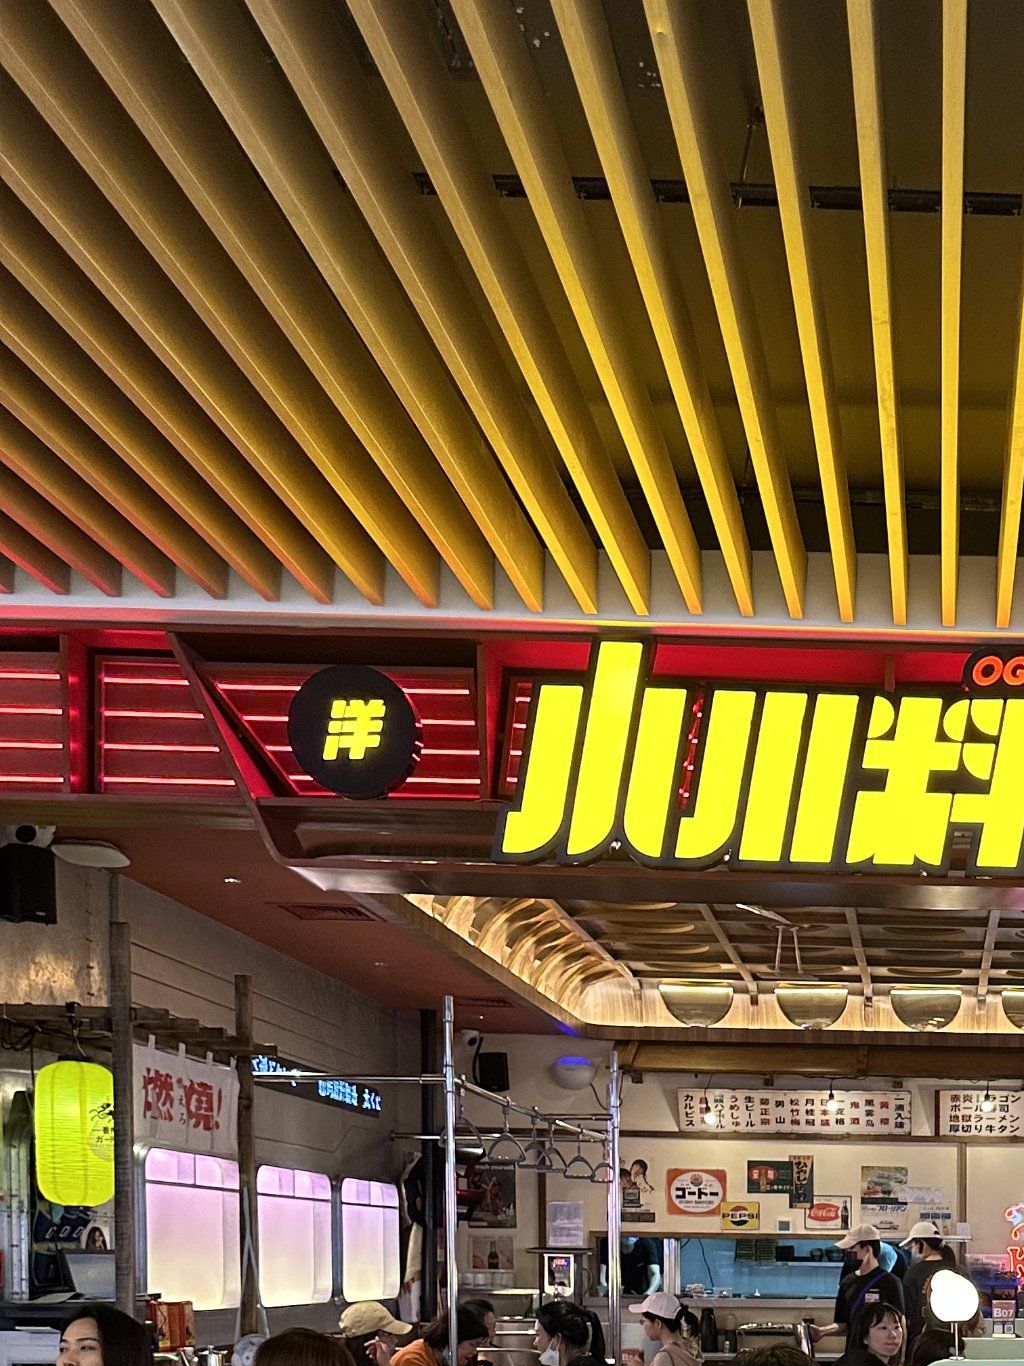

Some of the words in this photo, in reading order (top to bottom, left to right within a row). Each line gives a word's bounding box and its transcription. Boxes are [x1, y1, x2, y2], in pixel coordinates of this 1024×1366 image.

[322, 698, 385, 761] 洋
[949, 1114, 1021, 1124] 地獄ラーメン
[949, 1124, 1020, 1134] 厚切り牛タン
[675, 1186, 719, 1200] ゴードー
[722, 1212, 759, 1220] PEPSI
[993, 1308, 1014, 1318] B07
